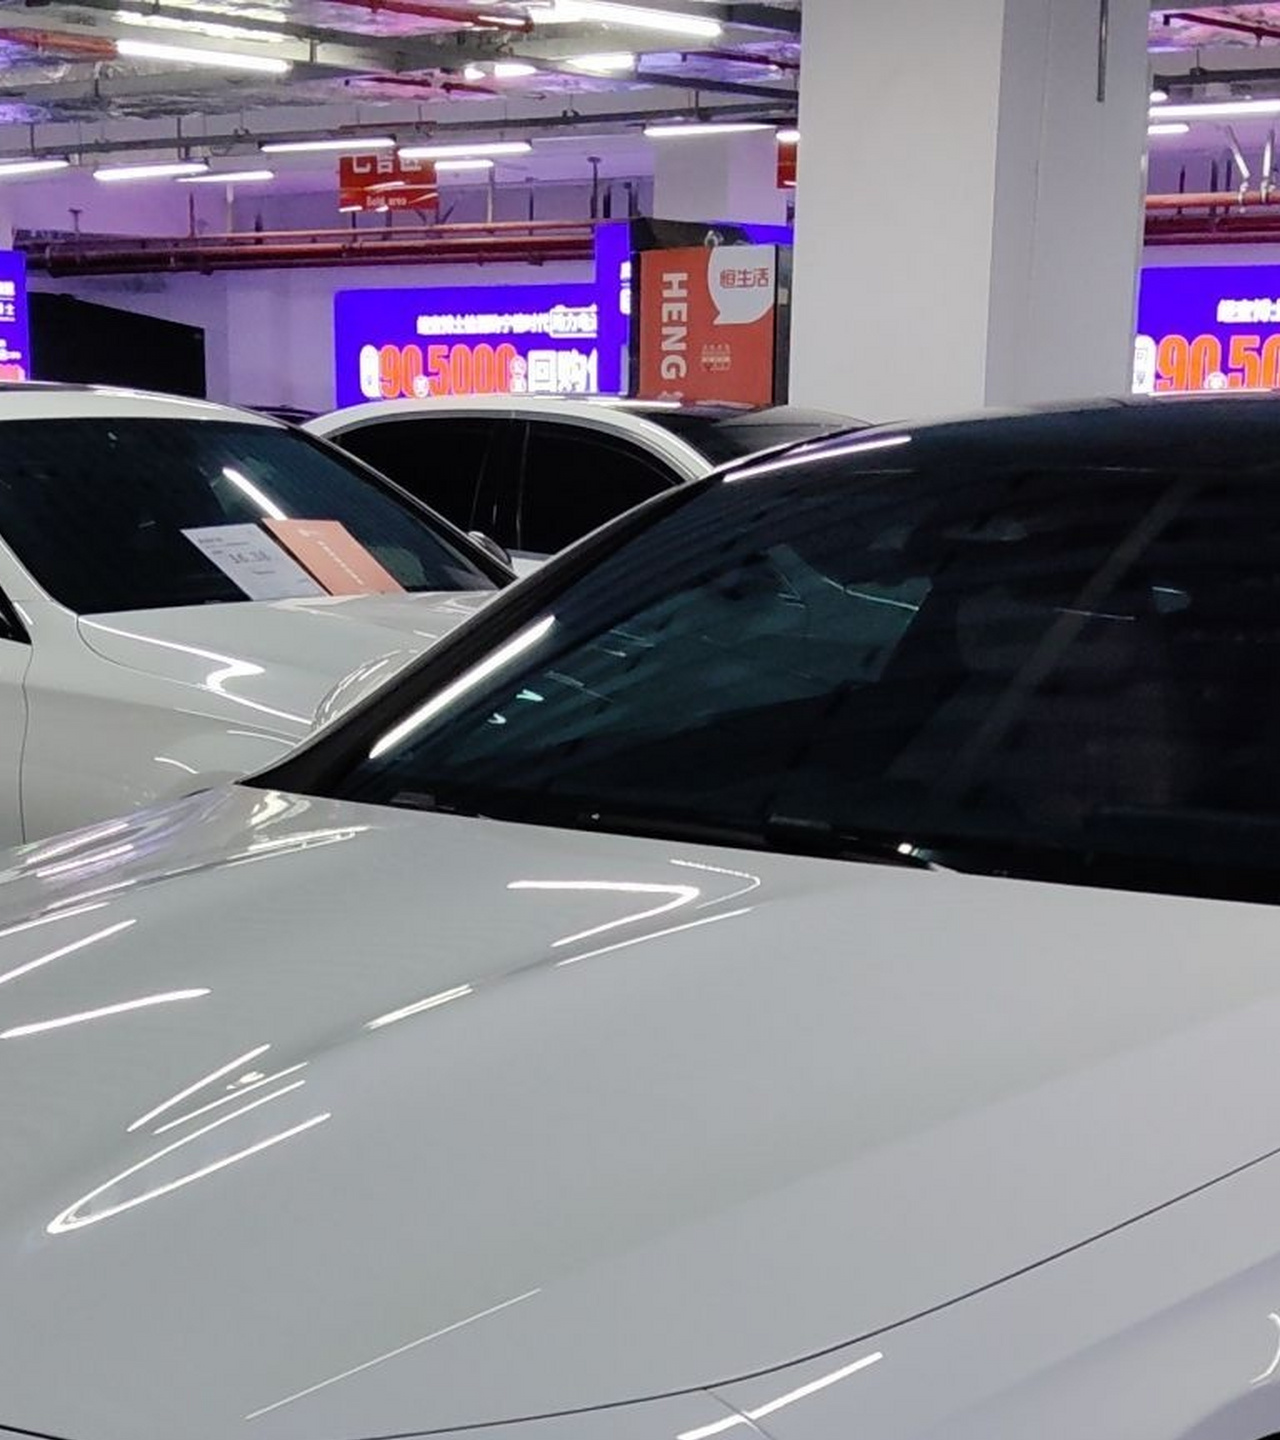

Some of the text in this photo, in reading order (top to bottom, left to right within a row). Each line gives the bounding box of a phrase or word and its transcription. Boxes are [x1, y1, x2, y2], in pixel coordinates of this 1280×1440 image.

[720, 268, 769, 289] 恒生活
[661, 272, 688, 380] HENG
